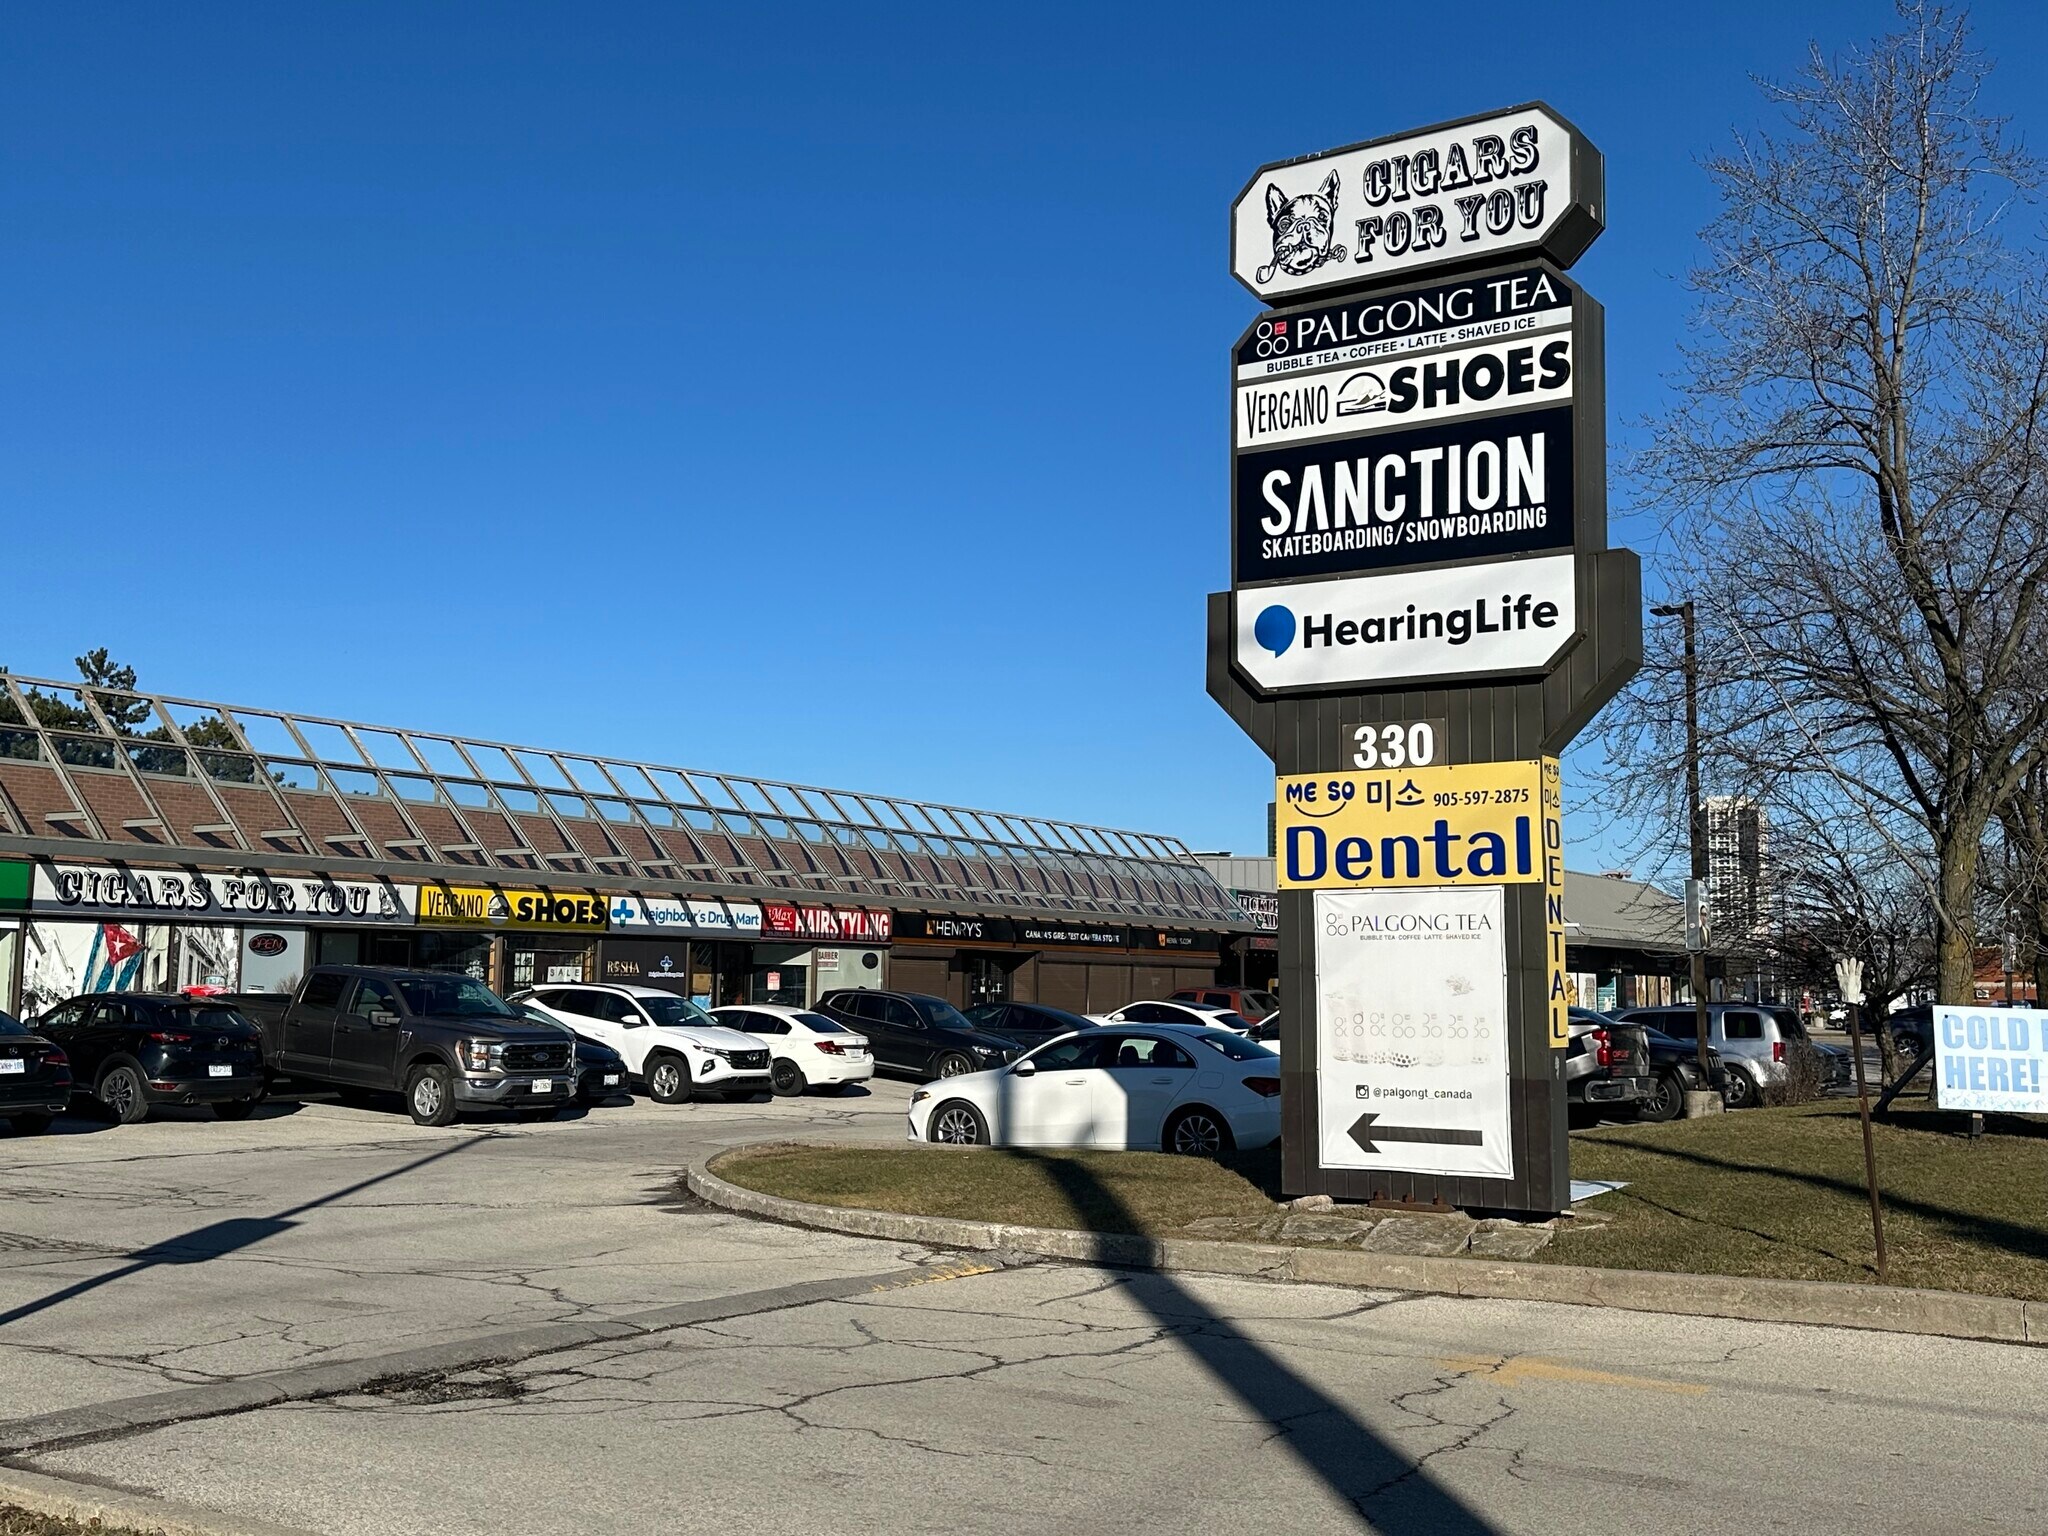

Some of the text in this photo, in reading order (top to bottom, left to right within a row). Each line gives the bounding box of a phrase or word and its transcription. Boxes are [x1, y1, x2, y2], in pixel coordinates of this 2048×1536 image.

[1363, 125, 1539, 207] CIGARS
[1355, 180, 1548, 263] FOR YOU
[1297, 274, 1557, 349] PALGONG TEA
[1266, 315, 1536, 374] BUBBLE TEA COFFEE LATTE SHAVED ICE
[1245, 340, 1571, 439] VERGANO SHOES
[1261, 432, 1545, 537] SANCTION
[1262, 506, 1547, 560] SKATEBOARDING/SNOWBOARDING
[1303, 594, 1559, 649] HearingLife
[1353, 722, 1434, 769] 330
[1286, 779, 1529, 812] ME SO 미소 905-597-2875
[1286, 816, 1532, 881] Dental
[55, 871, 370, 917] CIGARS FOR YOU
[428, 891, 606, 925] VERGANO SHOES
[640, 907, 759, 926] Neighbour's Drug Mart
[251, 936, 284, 949] OPEN
[795, 908, 889, 941] HAIRSTYLING
[936, 920, 983, 938] HENRY'S
[1352, 914, 1492, 932] PALGONG TEA
[1546, 818, 1566, 1039] DENTAL
[550, 969, 580, 977] SALE
[1942, 1014, 2030, 1052] COLD
[1373, 1086, 1473, 1101] @palgongt_canada
[1944, 1055, 2040, 1093] HERE!
